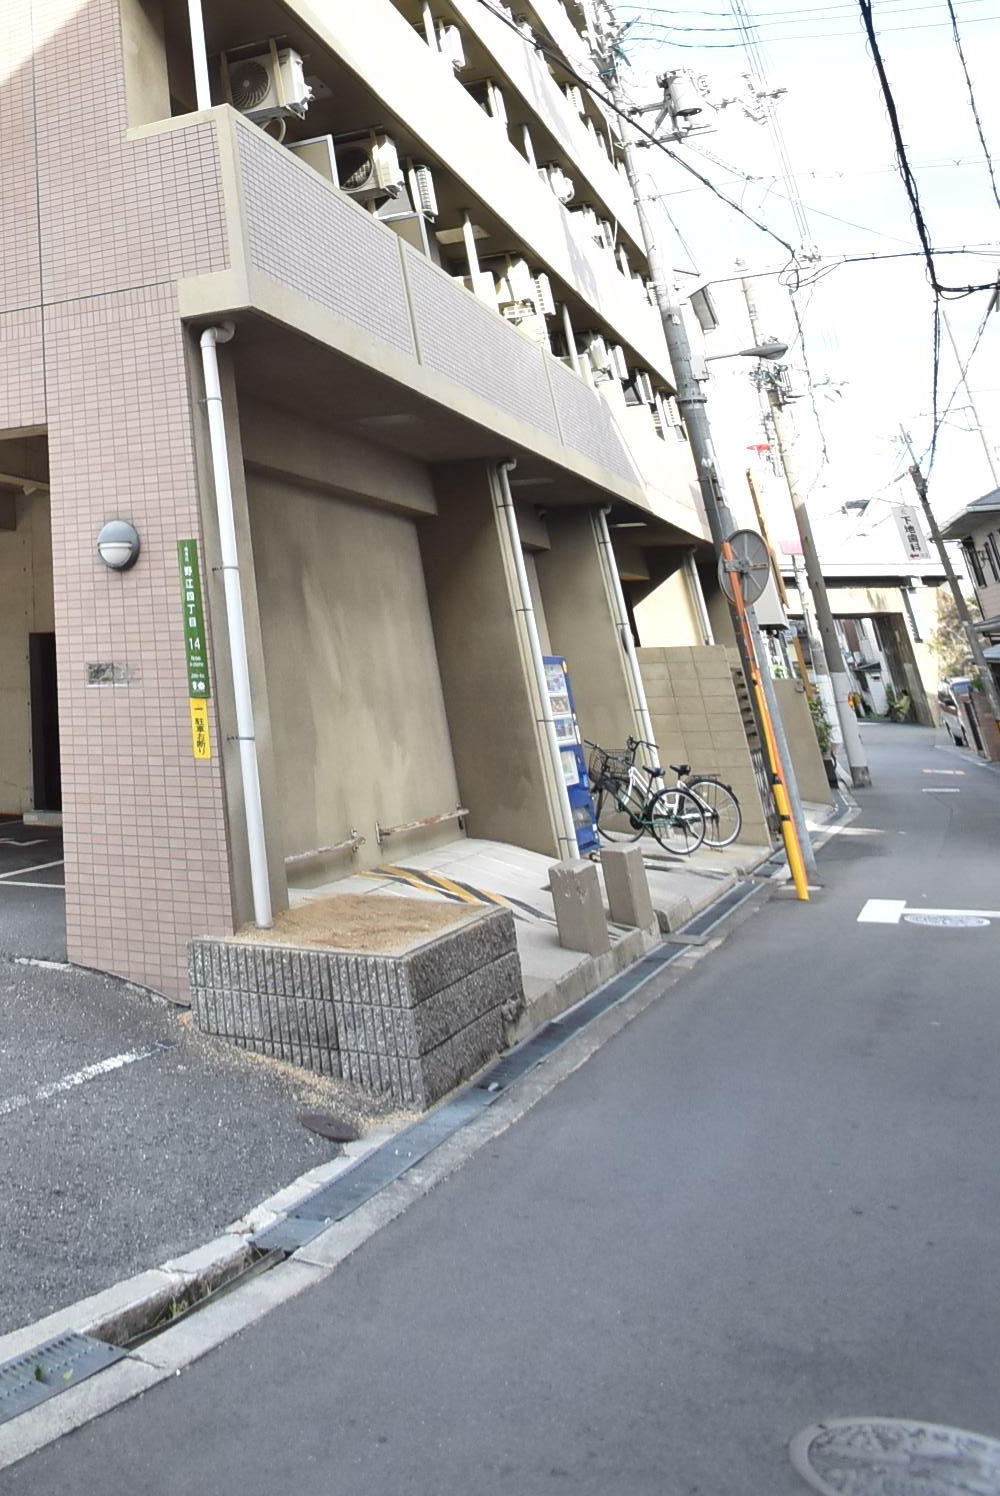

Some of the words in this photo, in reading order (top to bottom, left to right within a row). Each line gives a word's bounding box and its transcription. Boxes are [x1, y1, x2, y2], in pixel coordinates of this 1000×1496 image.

[183, 566, 197, 628] 野江四丁目
[189, 637, 201, 650] 14
